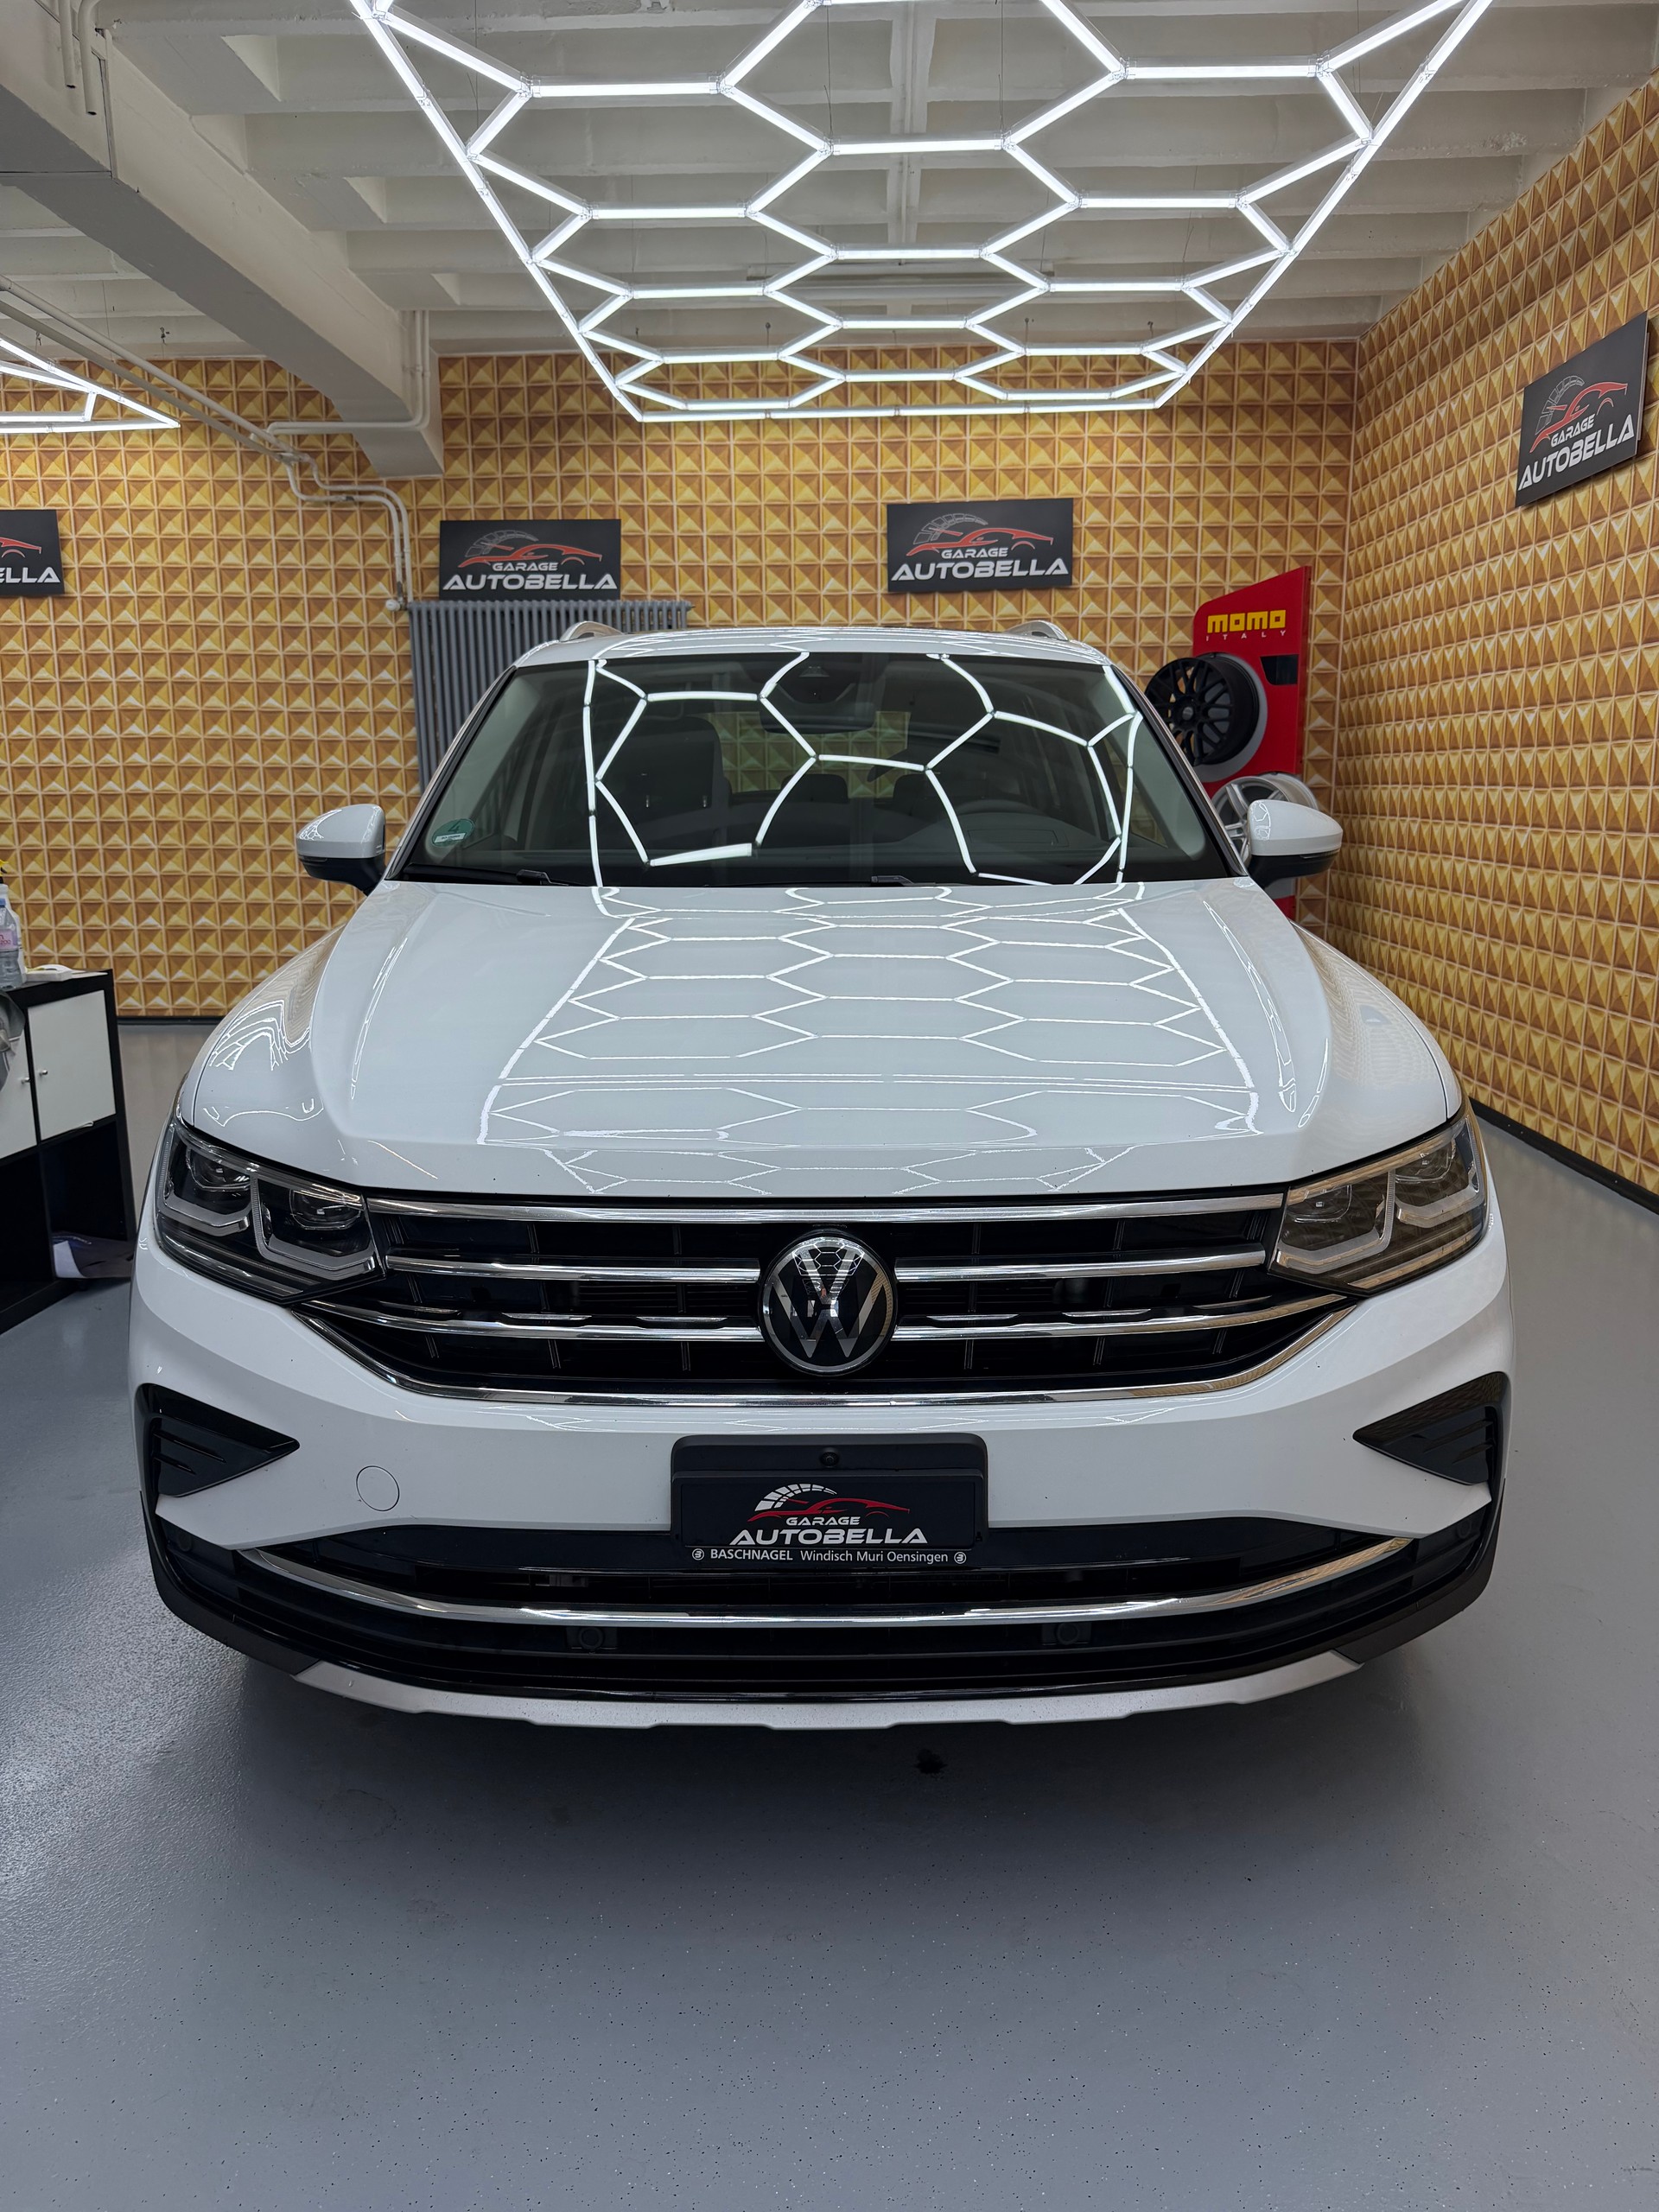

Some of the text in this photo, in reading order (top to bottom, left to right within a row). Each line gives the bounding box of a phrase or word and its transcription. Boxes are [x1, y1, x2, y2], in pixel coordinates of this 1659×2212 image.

[1550, 413, 1596, 448] GARAGE
[1517, 413, 1635, 491] AUTOBELLA
[941, 547, 1009, 559] GARAGE
[492, 562, 559, 572] GARAGE
[890, 557, 1070, 582] AUTOBELLA
[442, 573, 618, 590] AUTOBELLA
[1205, 630, 1287, 642] ITALY
[785, 1516, 861, 1527] GARAGE
[728, 1528, 929, 1546] AUTOBELLA
[709, 1548, 949, 1565] BASCHNAGEL Windisch Muri Oensingen
